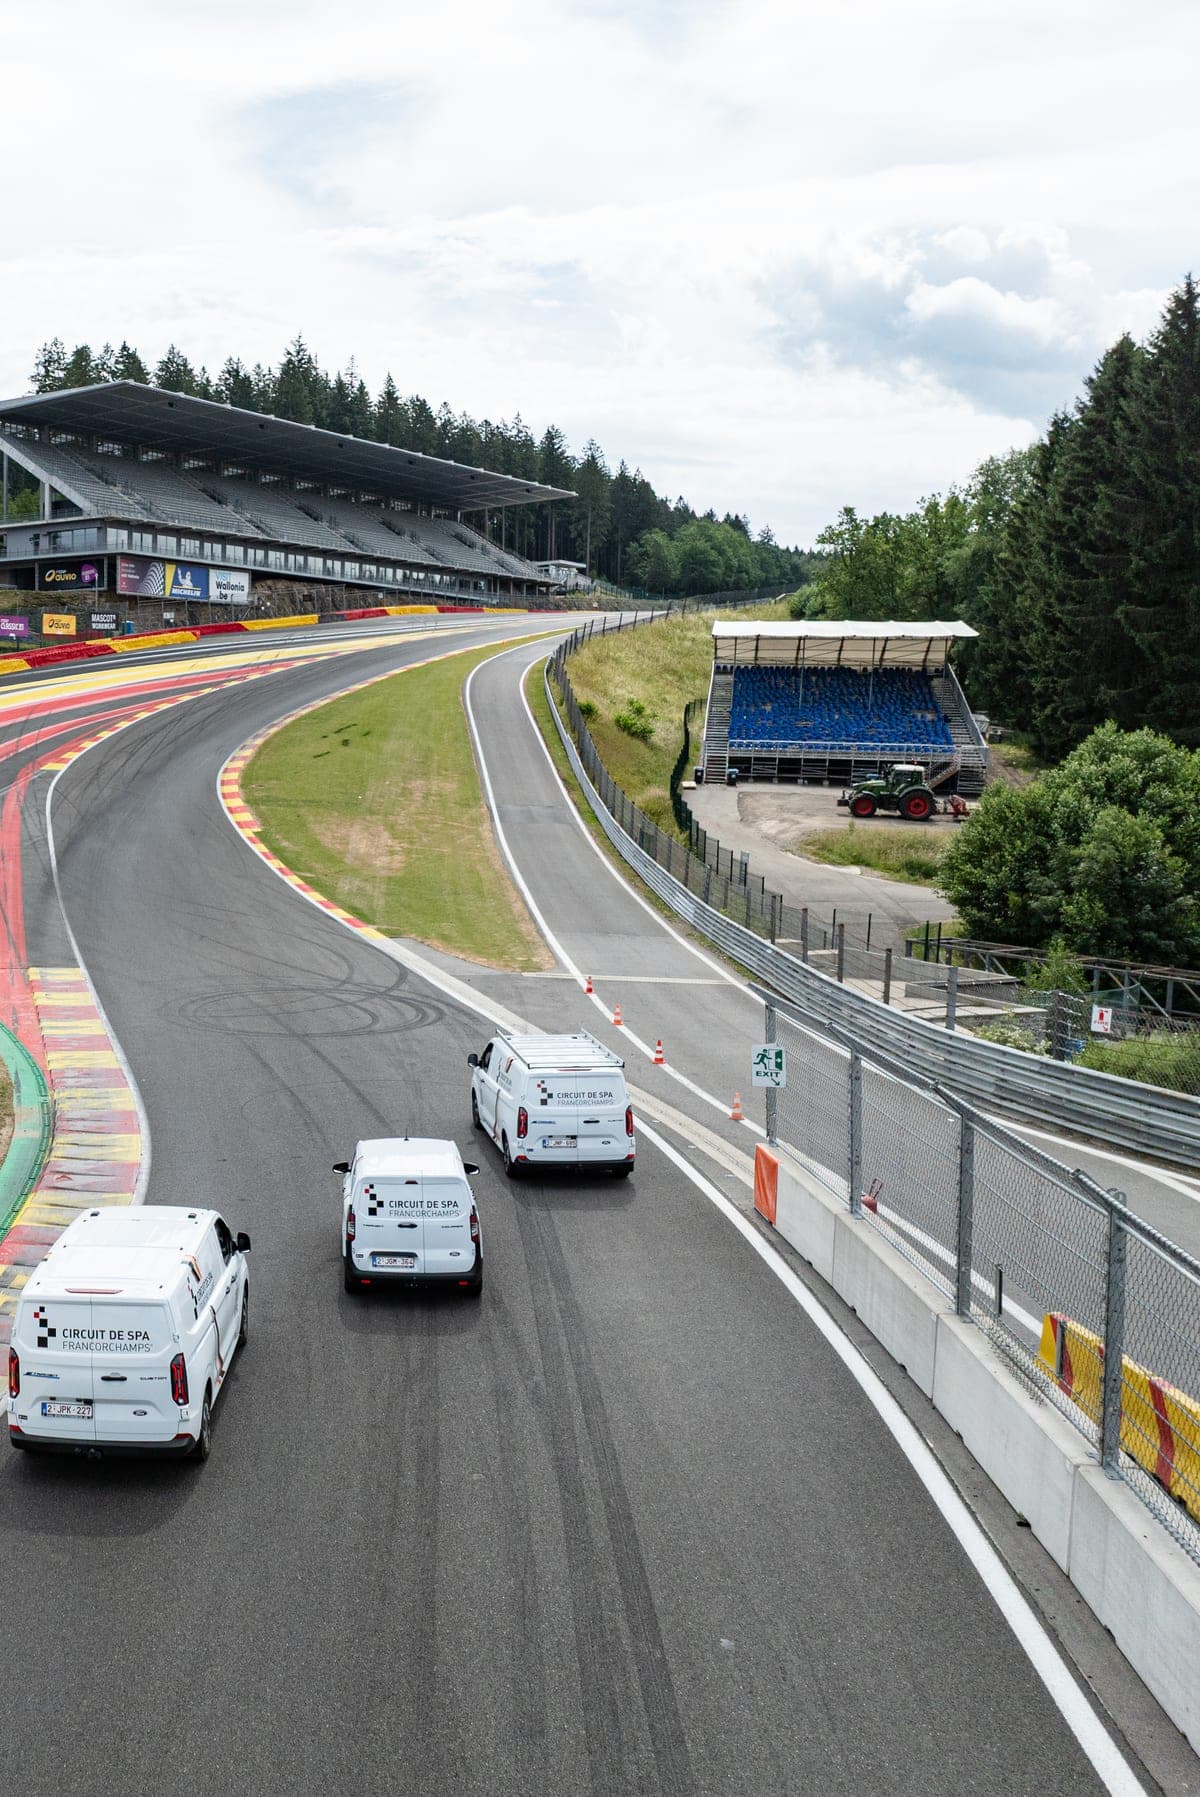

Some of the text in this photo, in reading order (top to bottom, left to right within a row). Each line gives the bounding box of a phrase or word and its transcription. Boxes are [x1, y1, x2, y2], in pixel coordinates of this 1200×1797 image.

[216, 580, 245, 591] Wallonia
[389, 1200, 459, 1209] CIRCUIT DE SPA
[389, 1209, 460, 1217] FRANCORCHAMPS
[62, 1328, 150, 1341] CIRCUIT DE SPA
[62, 1341, 151, 1352] FRANCORCHAMPS
